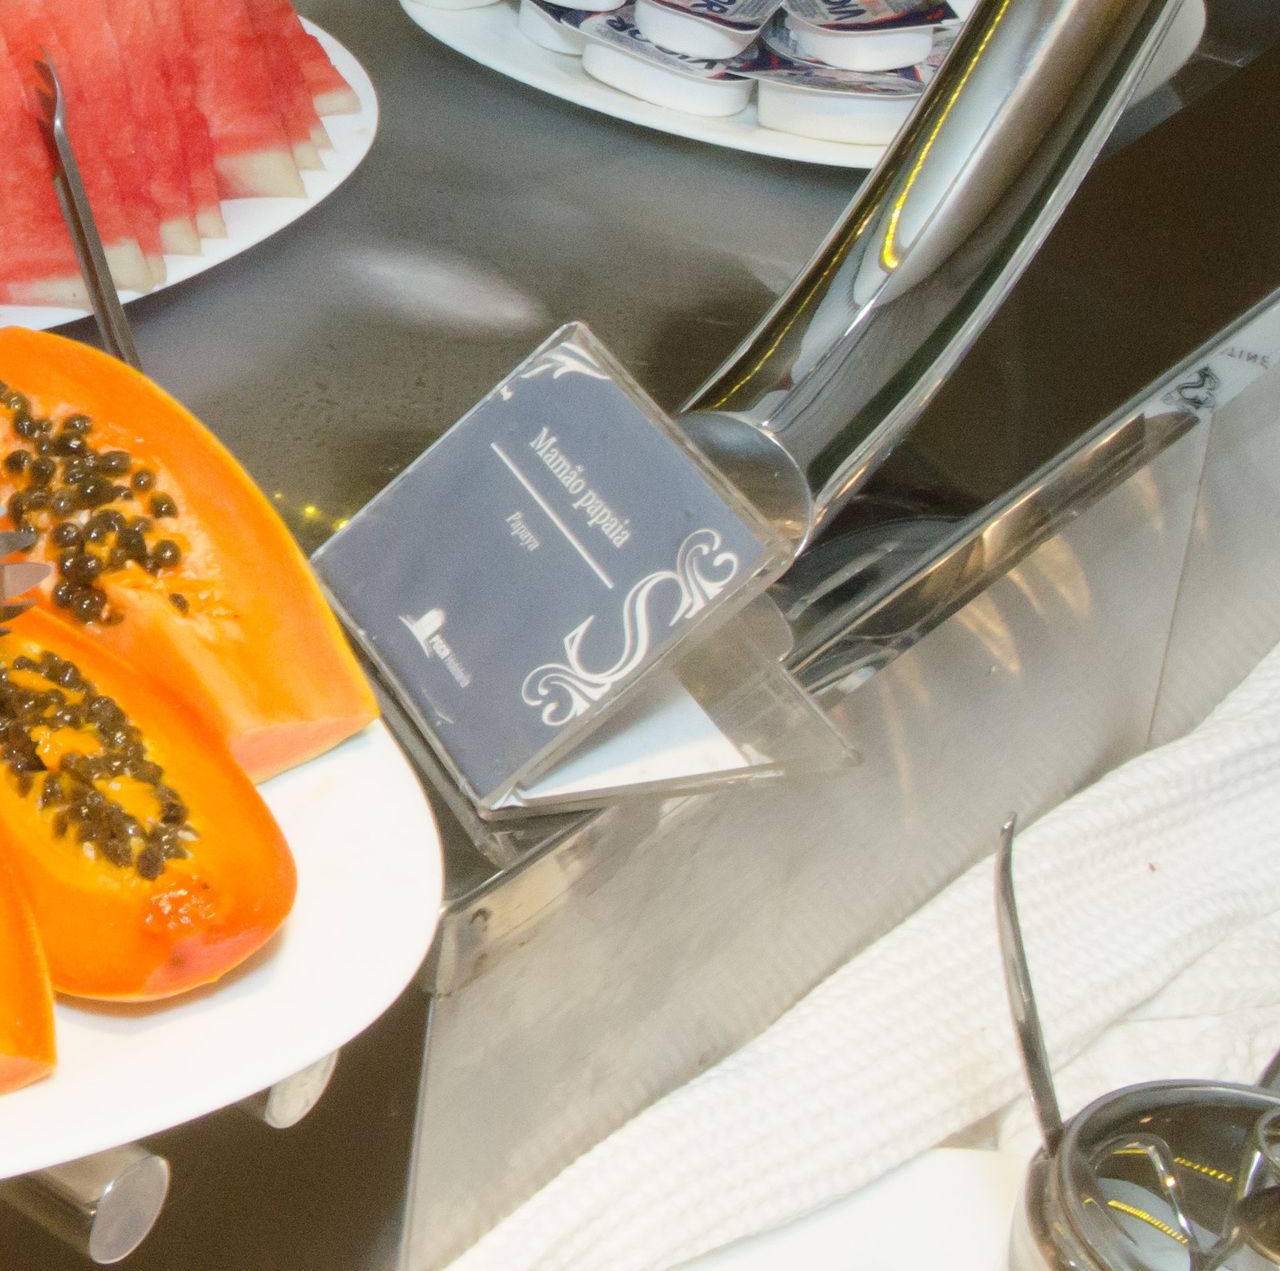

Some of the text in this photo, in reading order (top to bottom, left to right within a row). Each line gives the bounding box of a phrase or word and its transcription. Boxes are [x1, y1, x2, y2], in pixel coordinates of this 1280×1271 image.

[529, 426, 633, 549] Mamão papaia
[505, 511, 540, 552] Papaya
